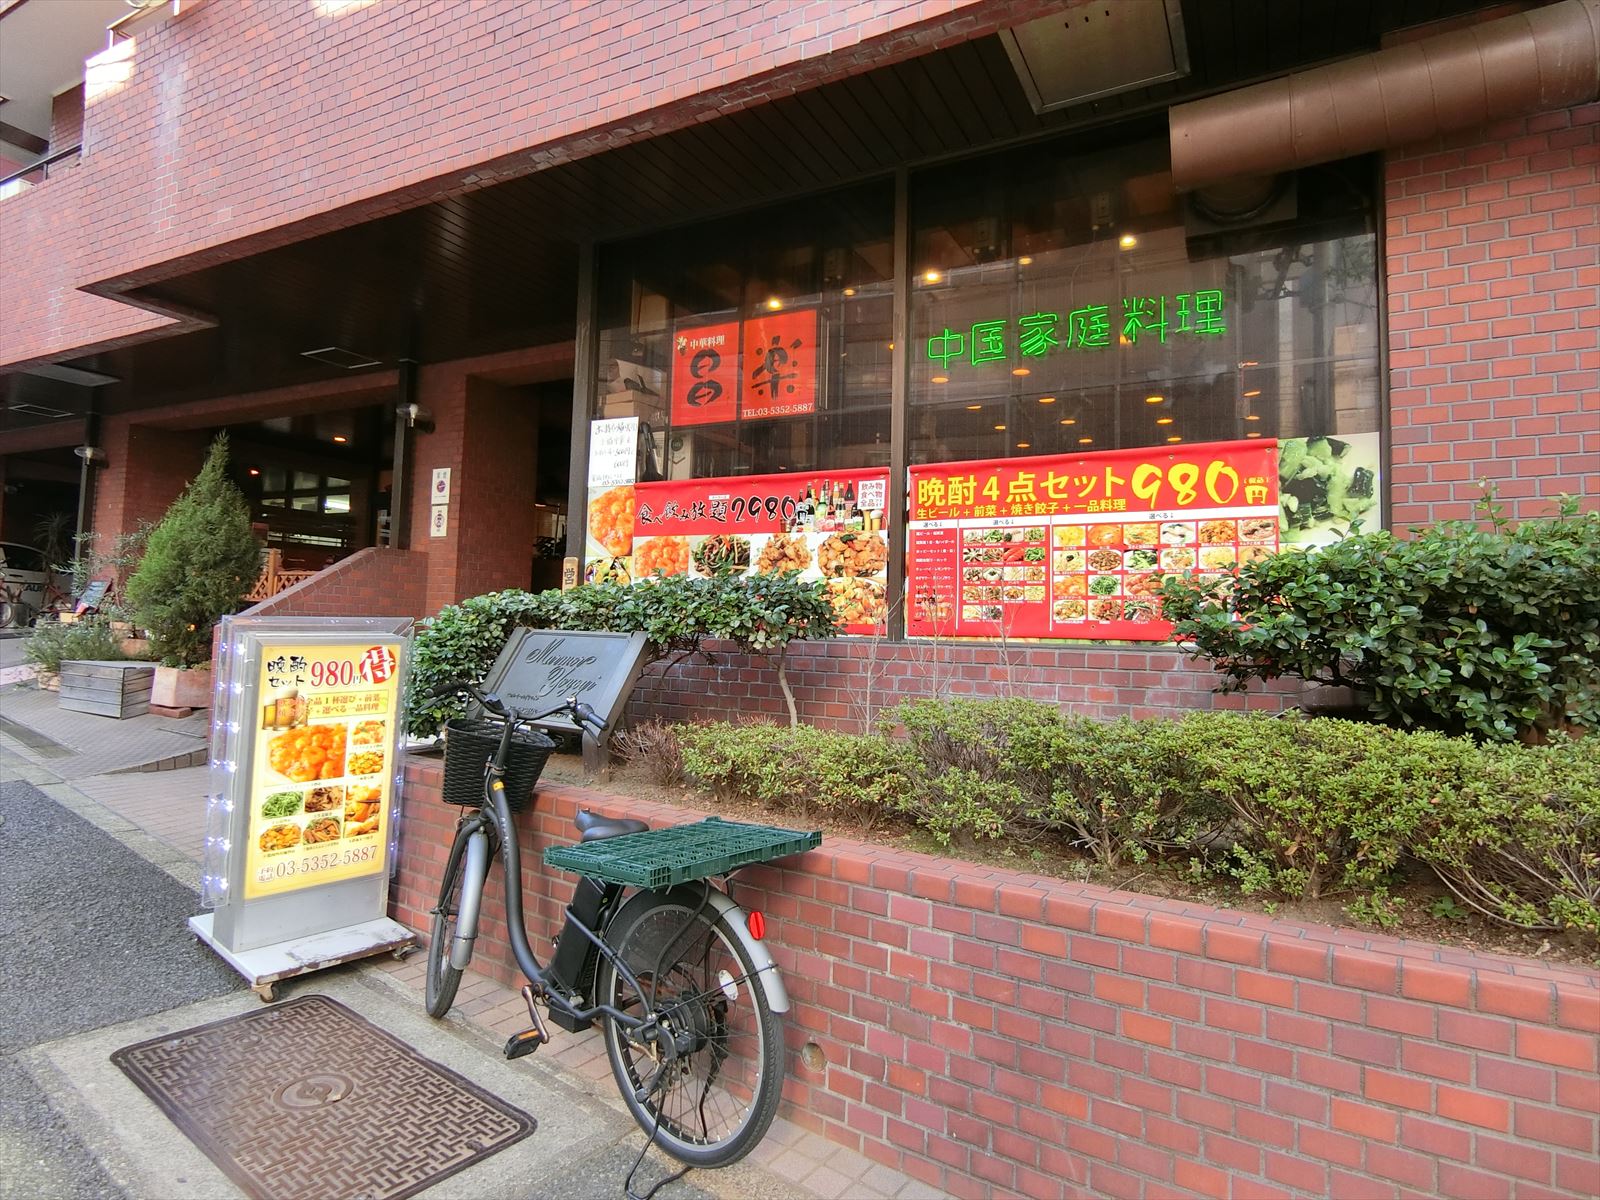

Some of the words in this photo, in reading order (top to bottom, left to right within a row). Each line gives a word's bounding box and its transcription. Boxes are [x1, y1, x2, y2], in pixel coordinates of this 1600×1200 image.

[690, 335, 725, 349] 中華料理
[743, 402, 813, 418] TEL:03-5352-5887
[861, 482, 882, 490] 飲み物
[917, 466, 1126, 507] 晩酌4点セット
[861, 490, 882, 499] 食べ物
[731, 495, 797, 524] 2980
[276, 845, 378, 878] 03-5352-5887
